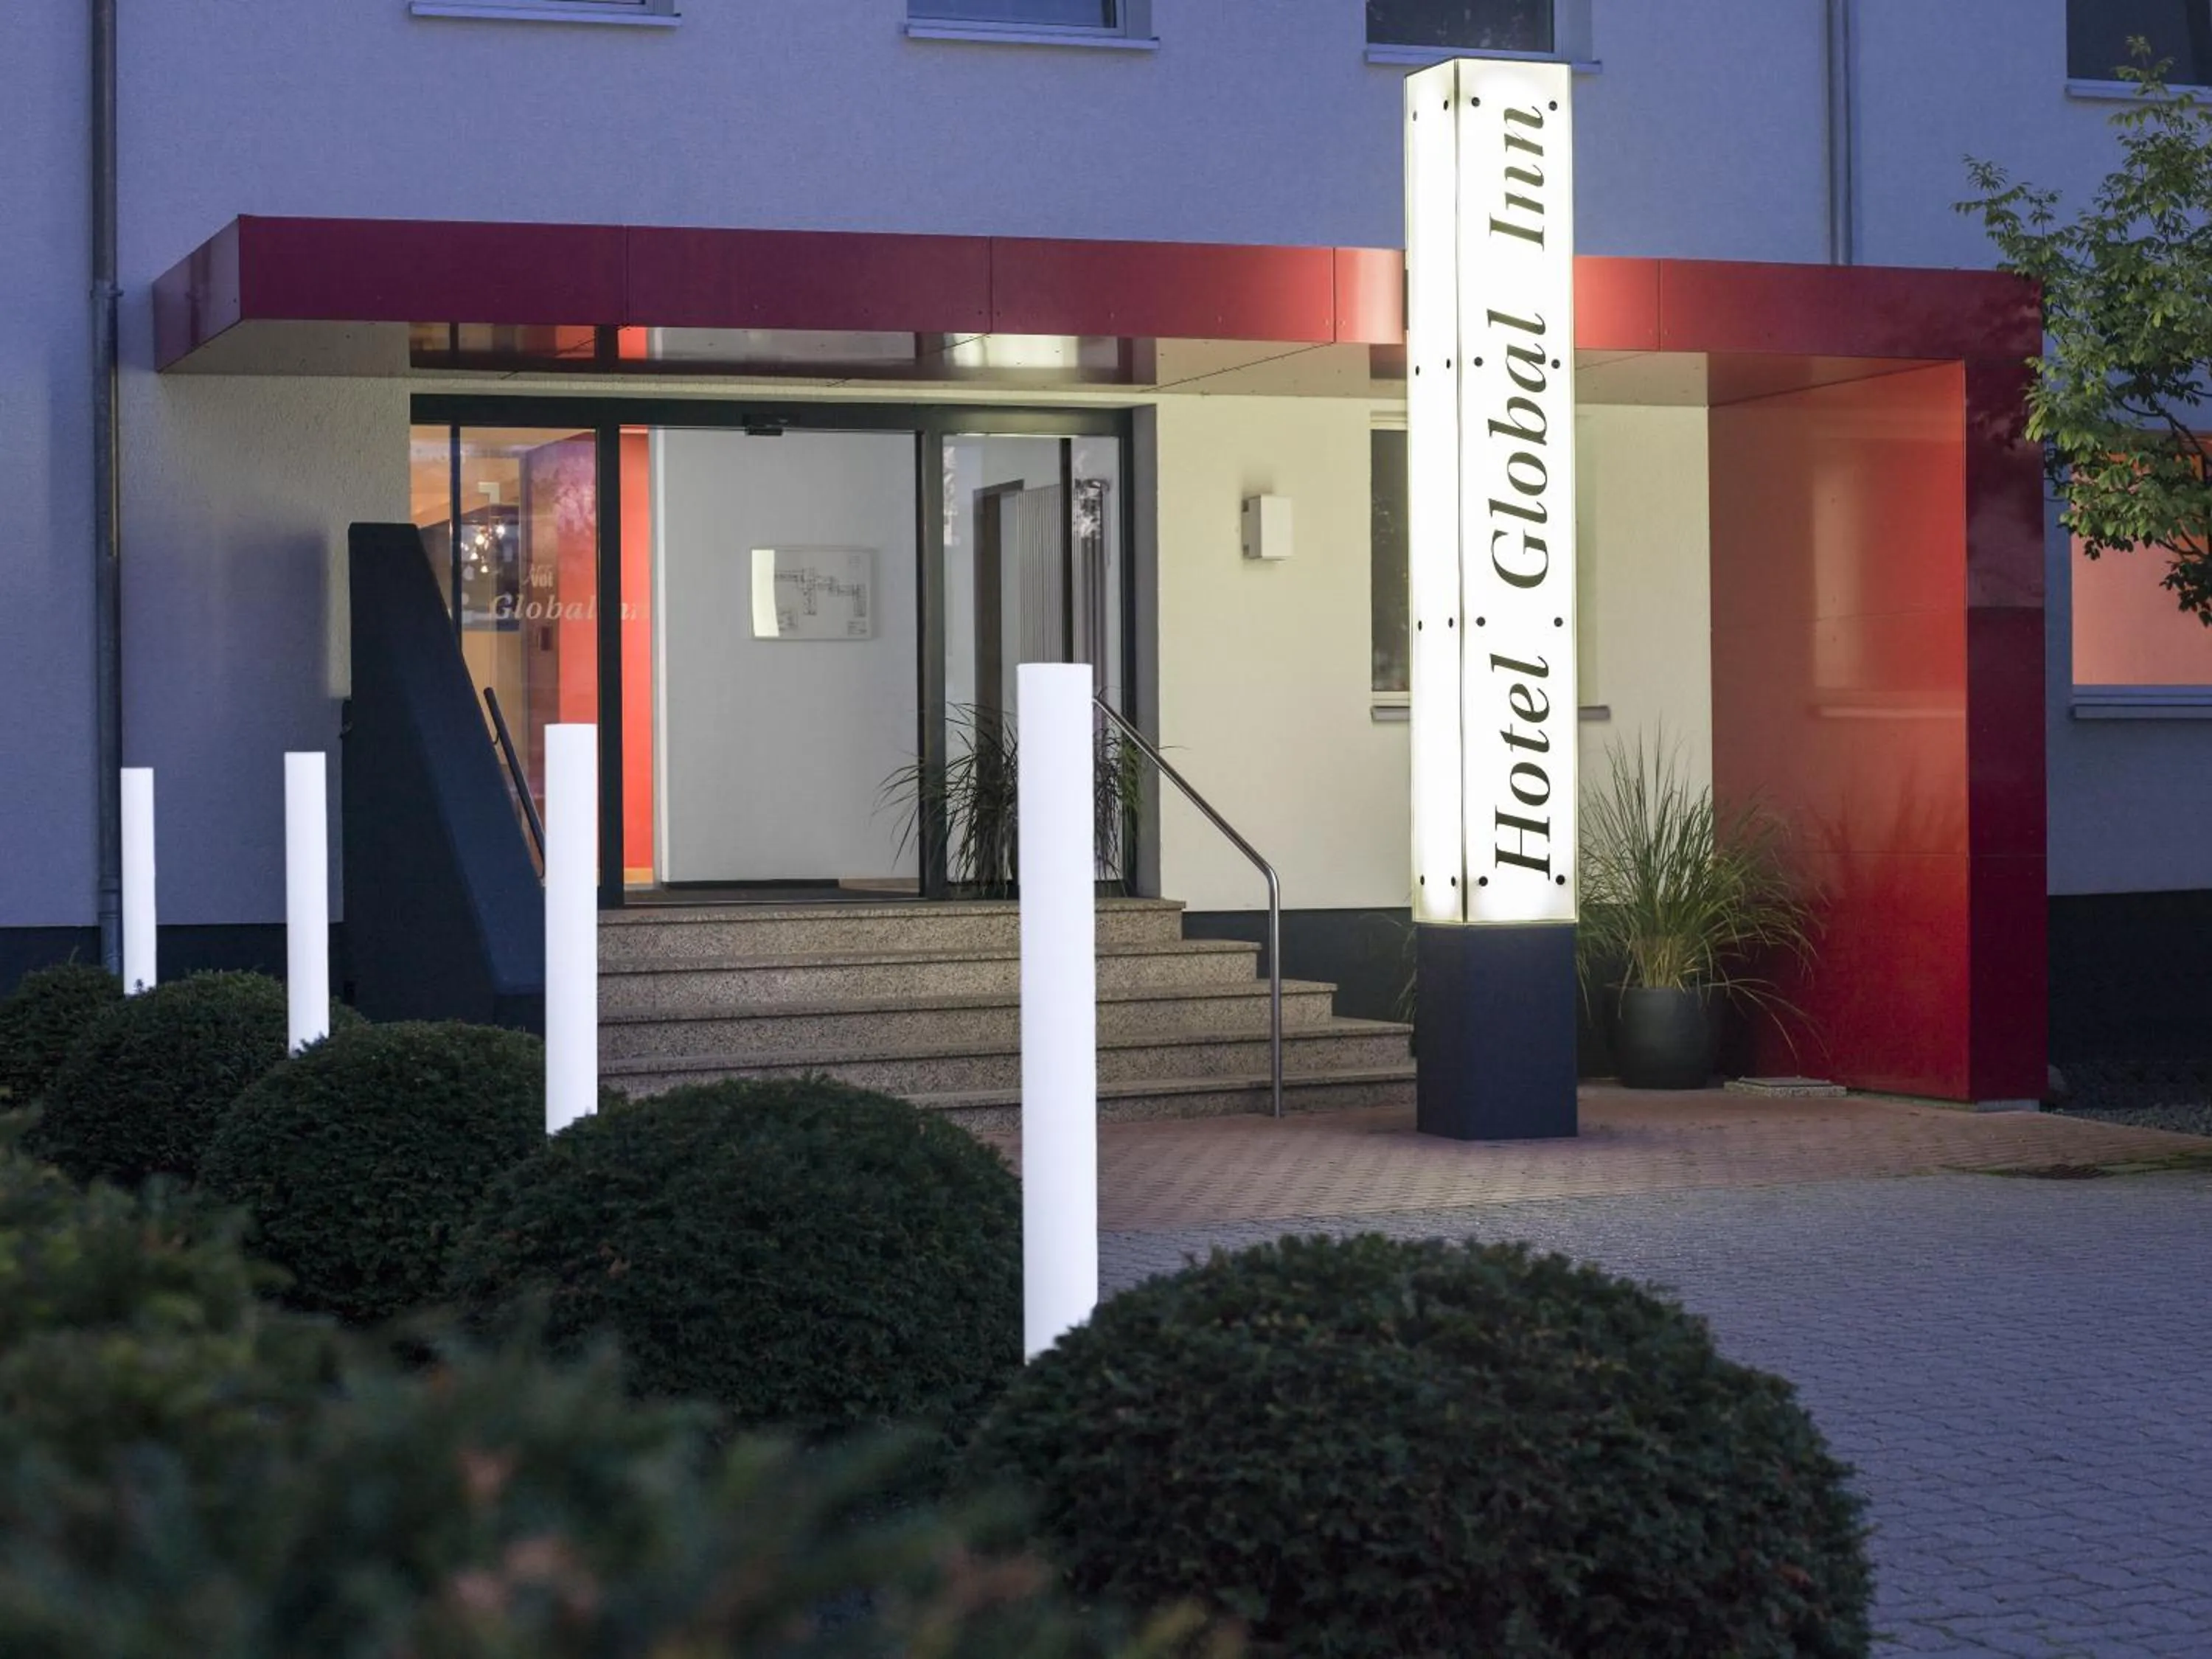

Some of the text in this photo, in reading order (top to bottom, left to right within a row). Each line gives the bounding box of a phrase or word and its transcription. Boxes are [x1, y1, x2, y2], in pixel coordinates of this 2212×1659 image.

[493, 594, 596, 621] Global
[1486, 105, 1551, 881] Hotel Global Inn
